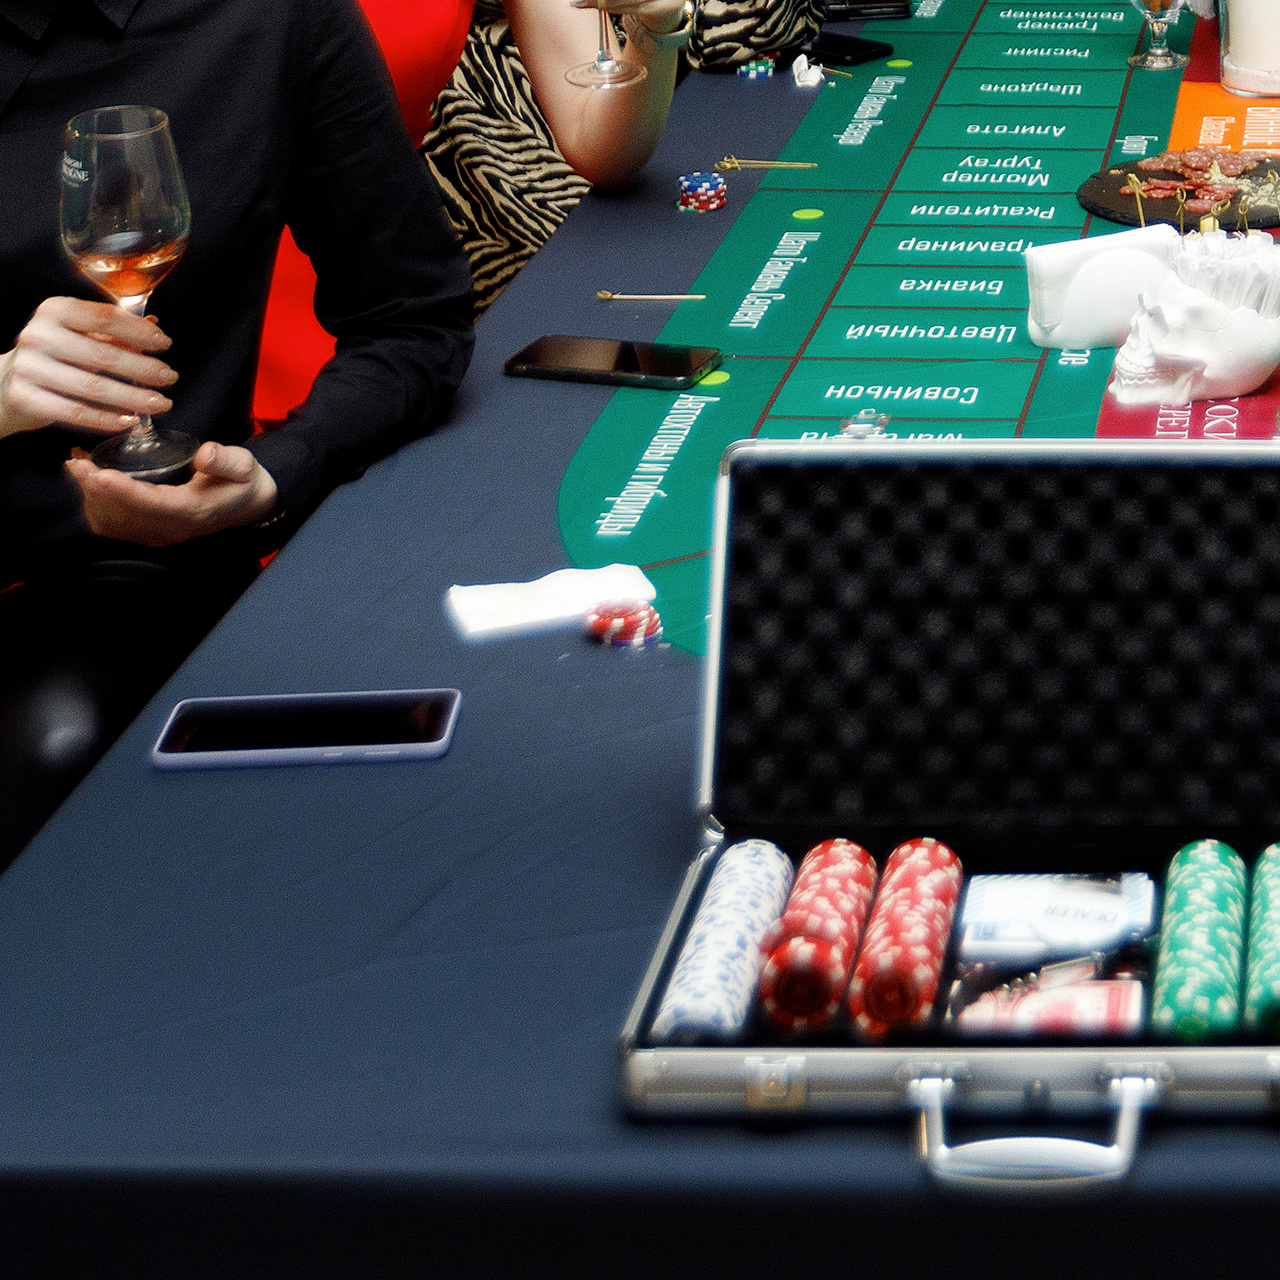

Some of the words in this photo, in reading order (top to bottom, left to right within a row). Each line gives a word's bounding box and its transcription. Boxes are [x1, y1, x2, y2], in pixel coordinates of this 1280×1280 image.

[1000, 10, 1124, 21] Вельтлинер
[1017, 21, 1098, 32] Грюнер
[1005, 48, 1089, 57] Рислинг
[981, 83, 1081, 94] Шардоне
[967, 125, 1065, 137] Алиготе
[959, 156, 1042, 170] Тургау
[942, 170, 1049, 186] Мюллер
[911, 205, 1055, 219] Ркацители
[900, 280, 1003, 295] Бианка
[846, 323, 1016, 343] Цветочный
[825, 386, 978, 404] Совиньон
[1044, 904, 1118, 921] DEALER
